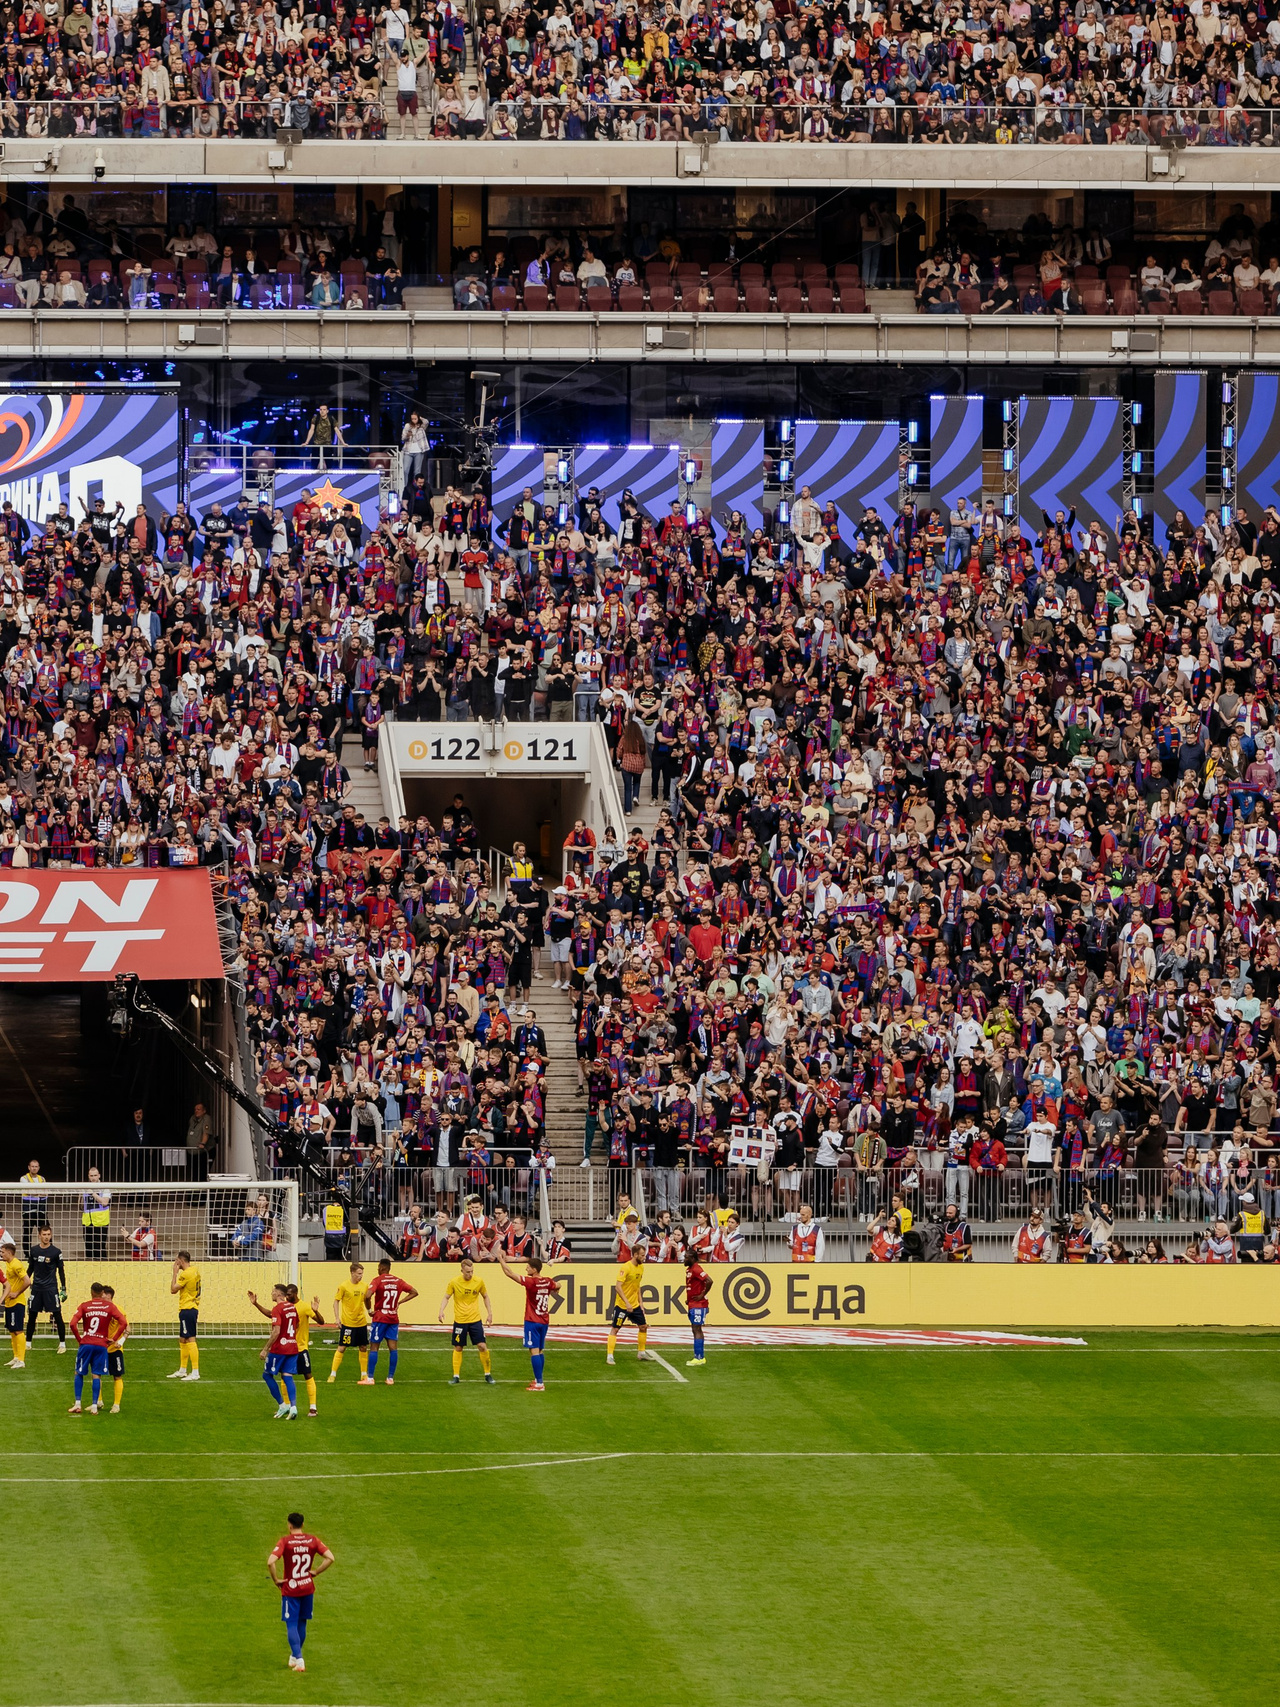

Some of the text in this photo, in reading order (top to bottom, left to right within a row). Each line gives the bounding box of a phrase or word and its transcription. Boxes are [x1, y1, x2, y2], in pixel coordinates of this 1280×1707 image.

[431, 738, 480, 760] 122
[527, 738, 577, 760] 121
[382, 1290, 398, 1309] 27
[787, 1273, 866, 1321] Еда
[87, 1316, 100, 1334] 9
[287, 1318, 295, 1337] 4
[292, 1554, 311, 1579] 22
